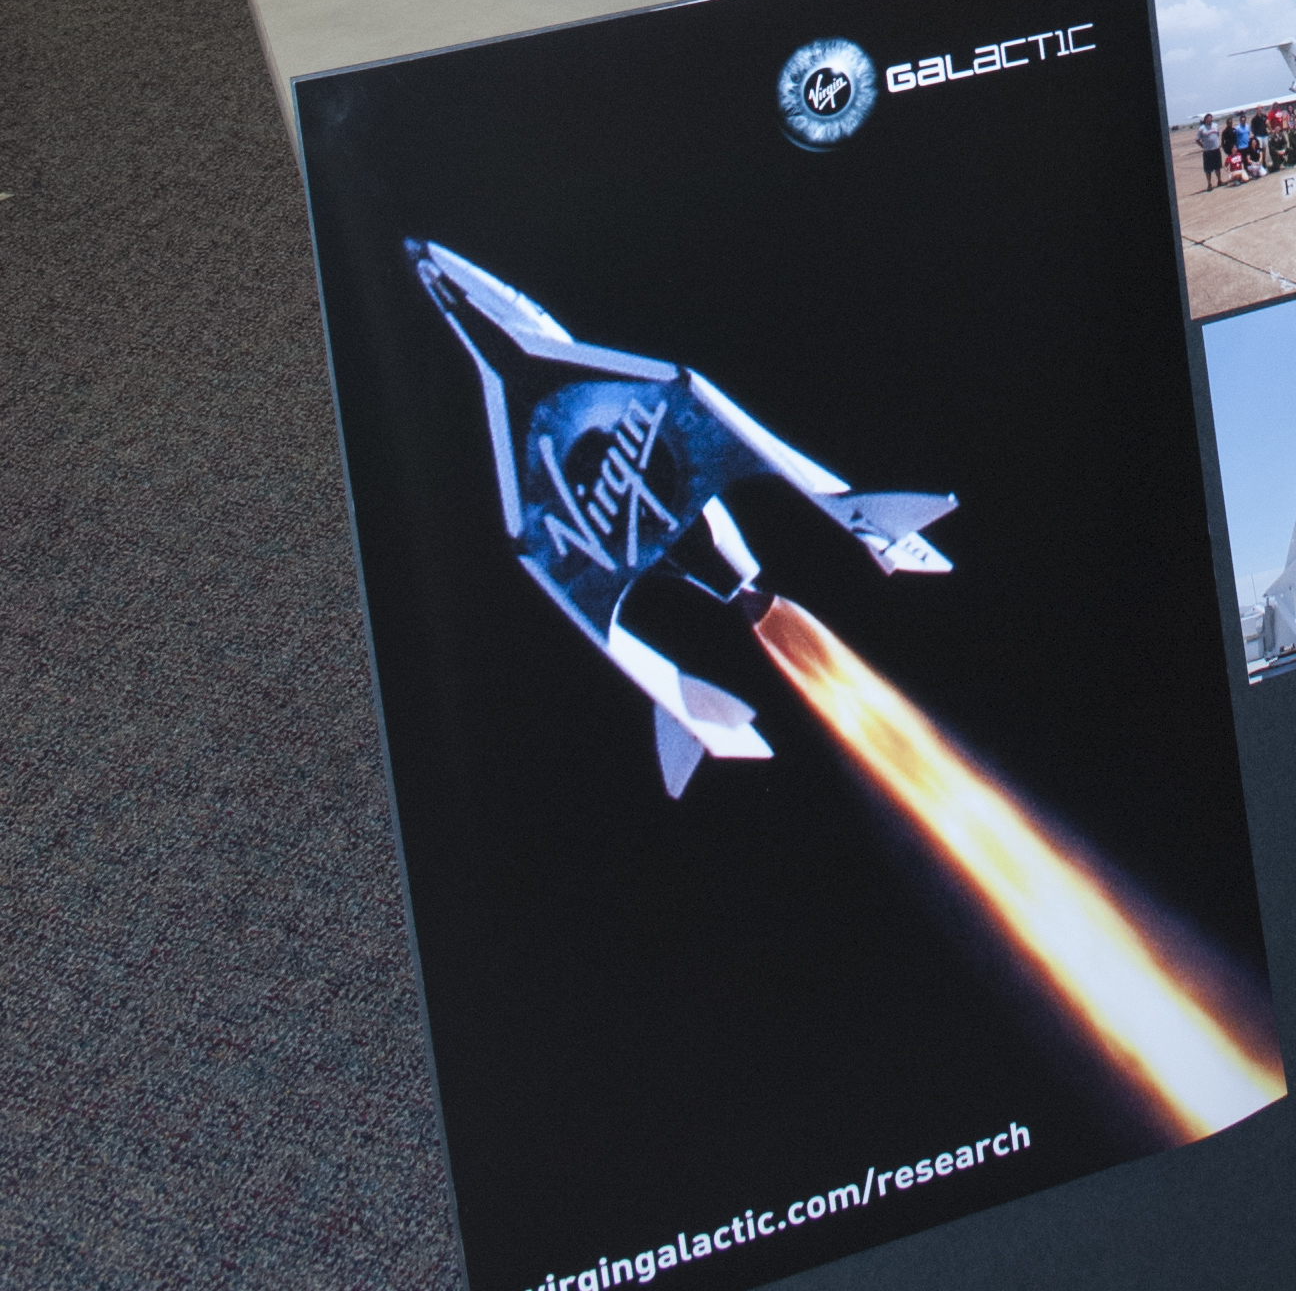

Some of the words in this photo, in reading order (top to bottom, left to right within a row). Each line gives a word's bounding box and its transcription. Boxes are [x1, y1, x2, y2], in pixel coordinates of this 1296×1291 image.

[808, 74, 847, 111] Virgin
[886, 23, 1096, 93] GALACTIC
[538, 398, 679, 572] Virgin
[525, 1121, 1032, 1291] irgingalactic.com/research
